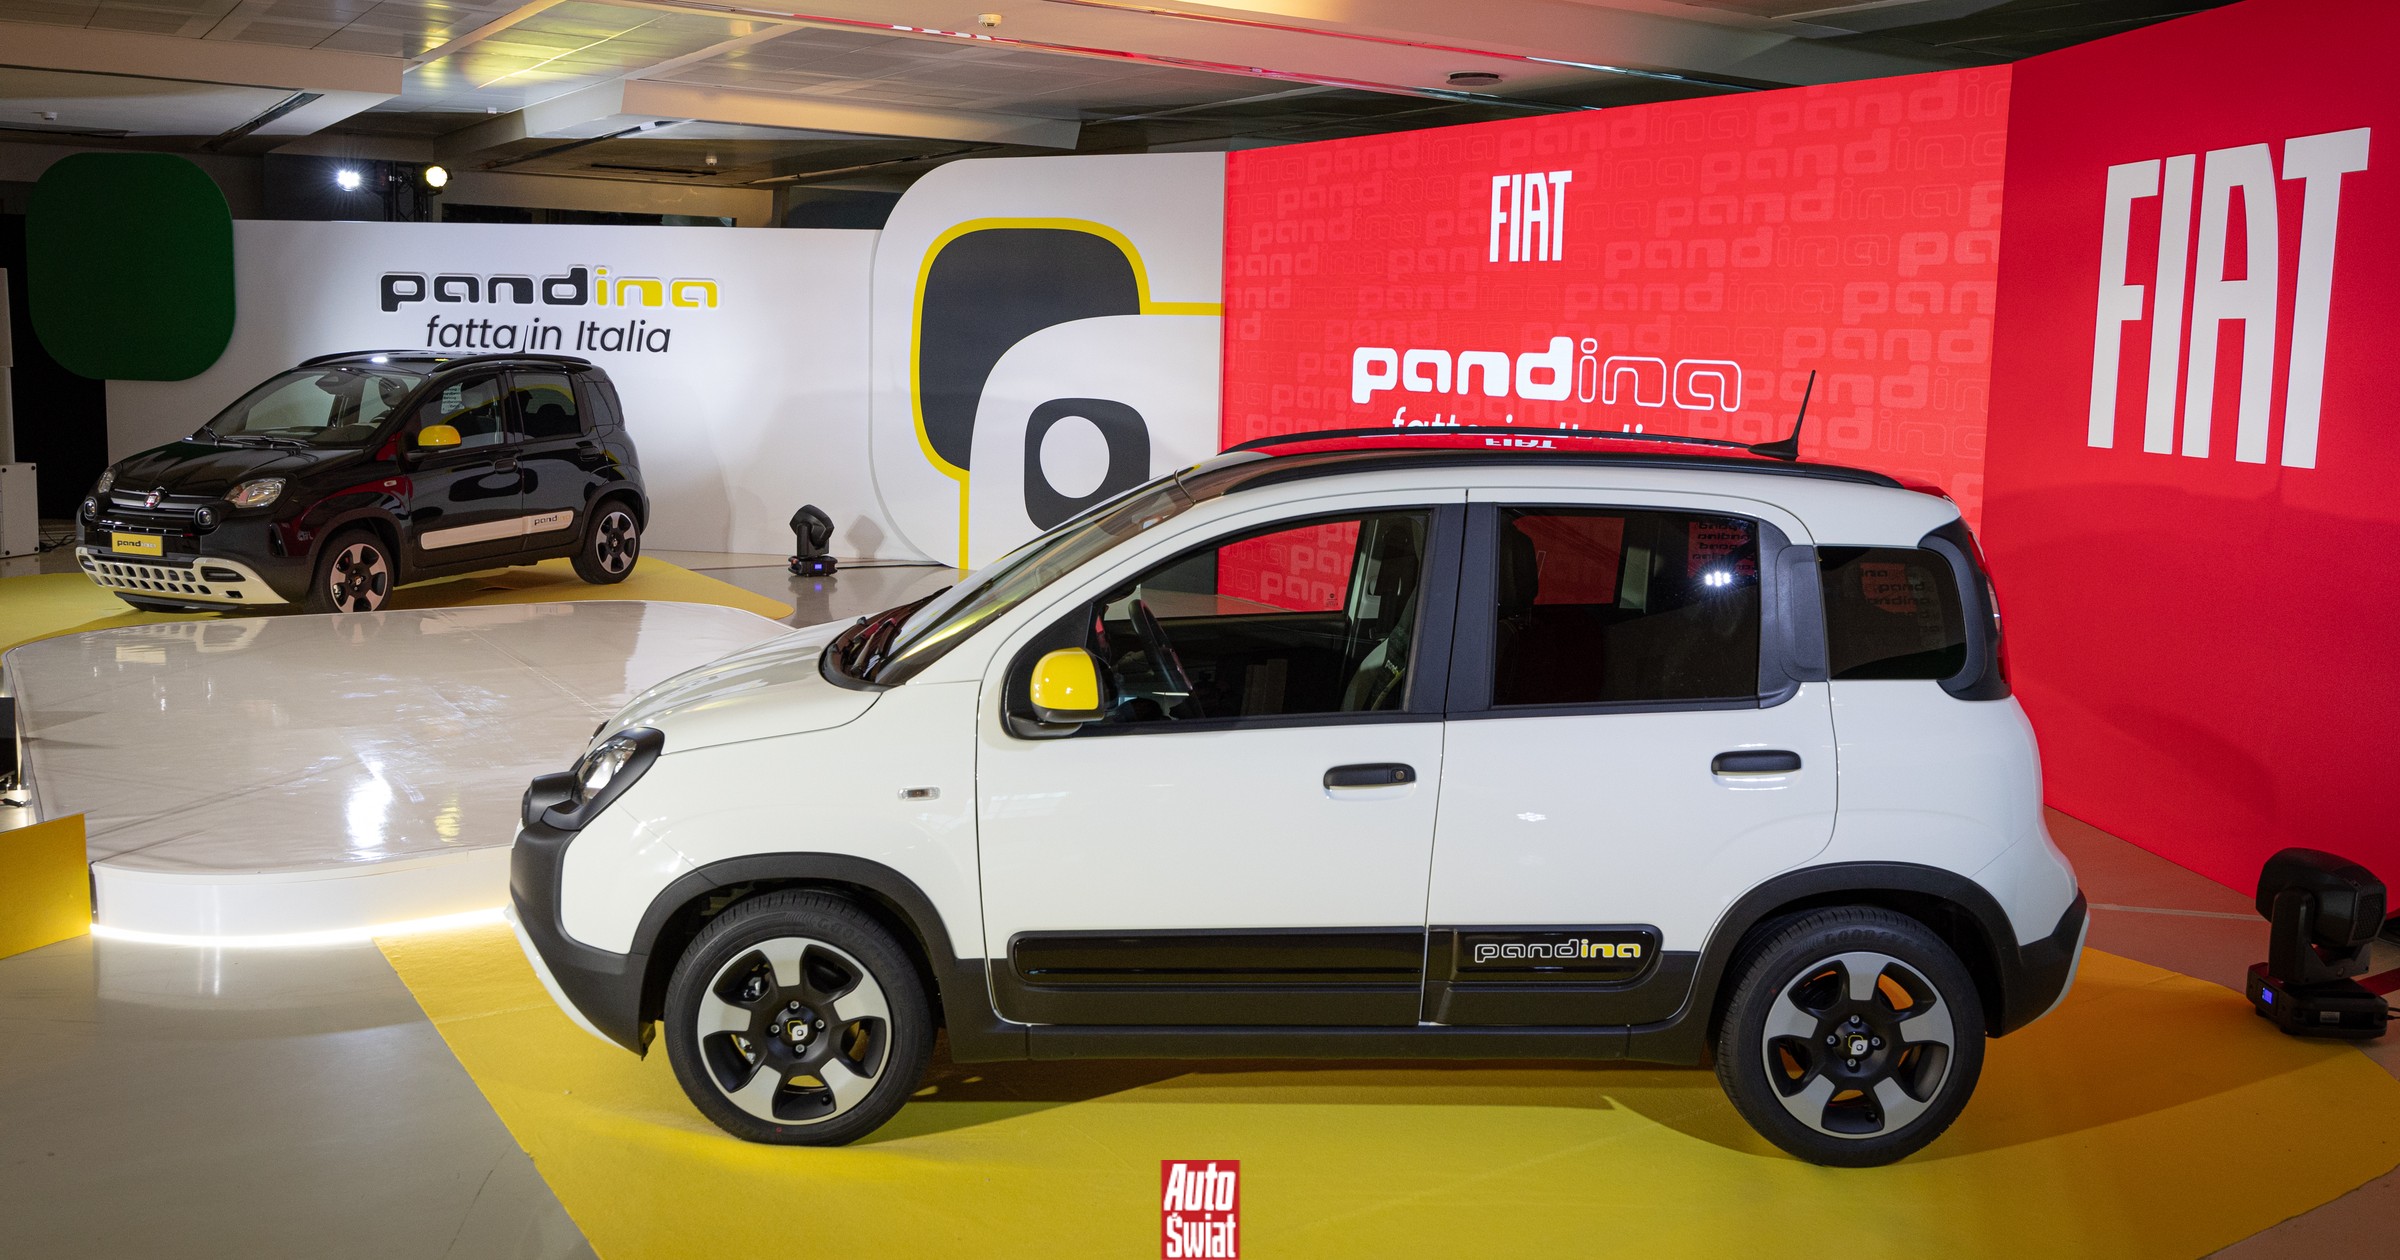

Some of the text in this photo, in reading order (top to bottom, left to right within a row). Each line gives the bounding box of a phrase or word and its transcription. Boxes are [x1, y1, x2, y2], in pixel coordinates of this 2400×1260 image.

[1489, 170, 1572, 262] FIAT
[1655, 177, 1961, 238] pandina
[1604, 224, 1890, 279] pandina
[380, 266, 718, 312] pandina
[2087, 127, 2371, 469] FIAT
[426, 315, 671, 353] fatta in Italia
[1352, 335, 1741, 413] pandina
[1474, 939, 1641, 963] pandina
